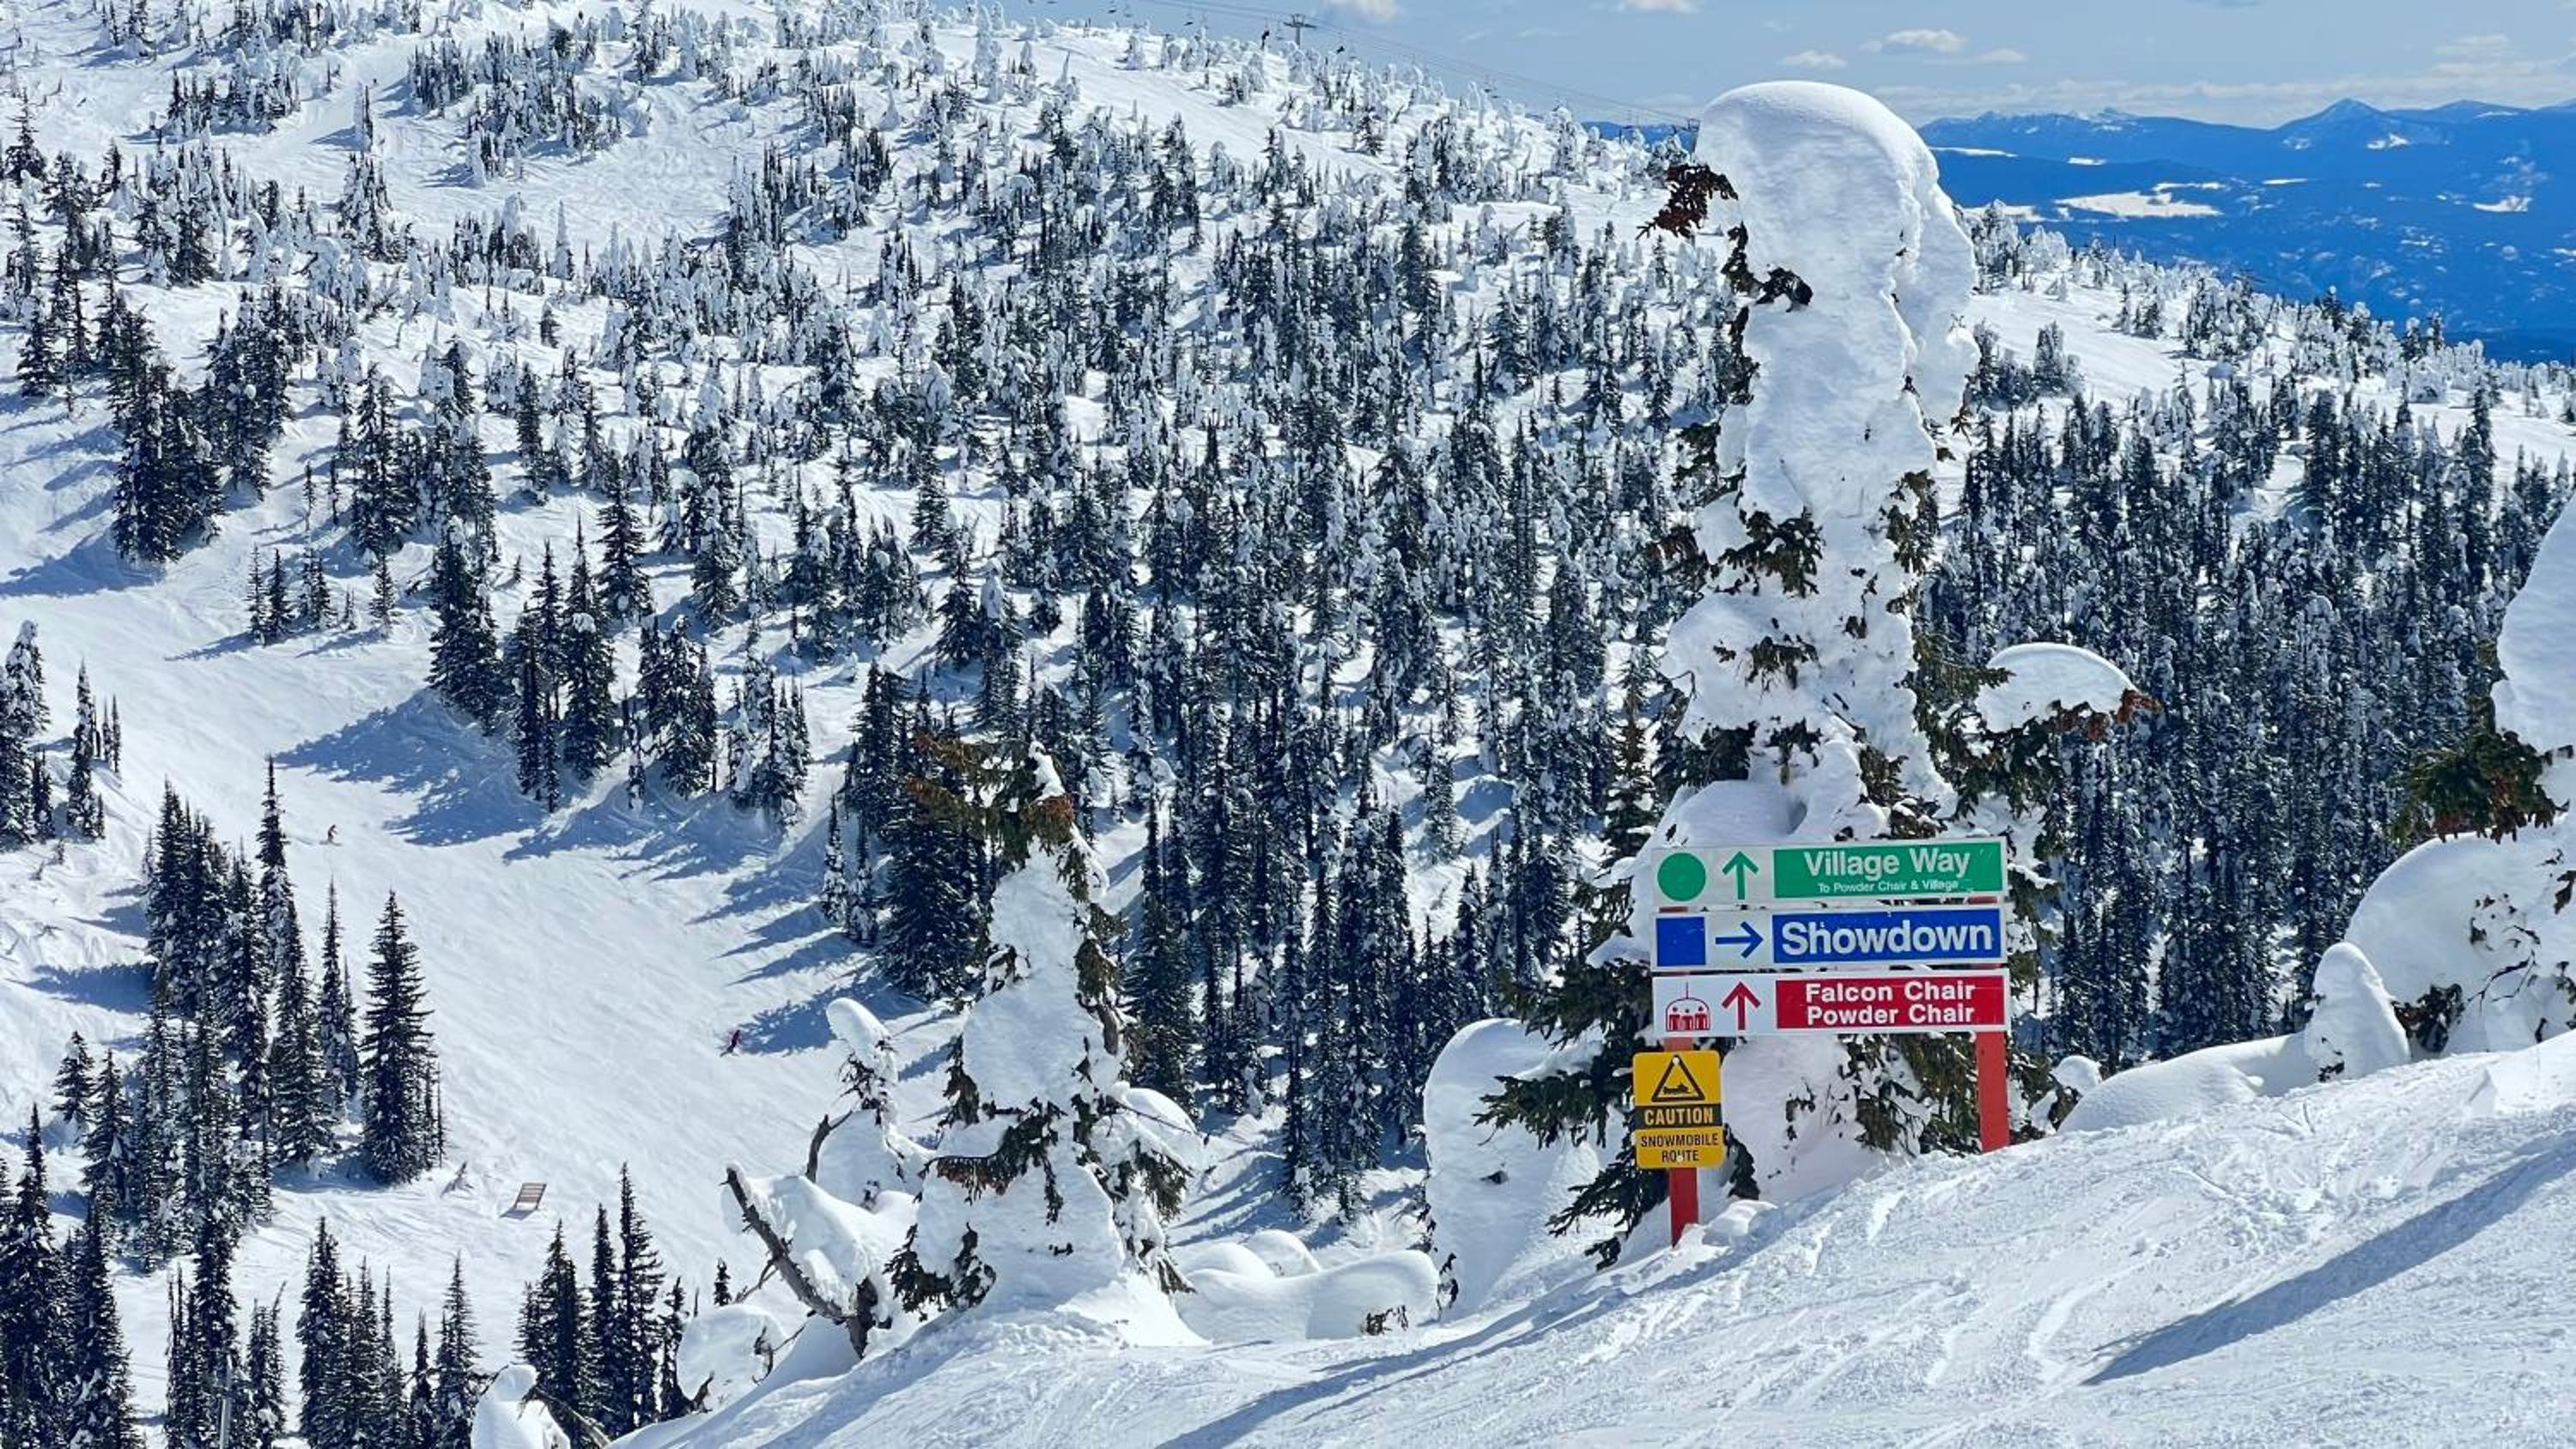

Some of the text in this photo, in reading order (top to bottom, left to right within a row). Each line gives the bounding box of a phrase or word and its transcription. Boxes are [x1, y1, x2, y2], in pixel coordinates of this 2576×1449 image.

[1804, 847, 1971, 880] Village Way
[1819, 880, 1959, 894] To Powder Chair & Village
[1781, 920, 1992, 955] Showdown
[1806, 980, 1976, 1003] Falcon Chair
[1807, 1003, 1976, 1025] Powder Chair
[1644, 1107, 1713, 1125] CAUTION
[1641, 1133, 1718, 1147] SNOWMOBILE
